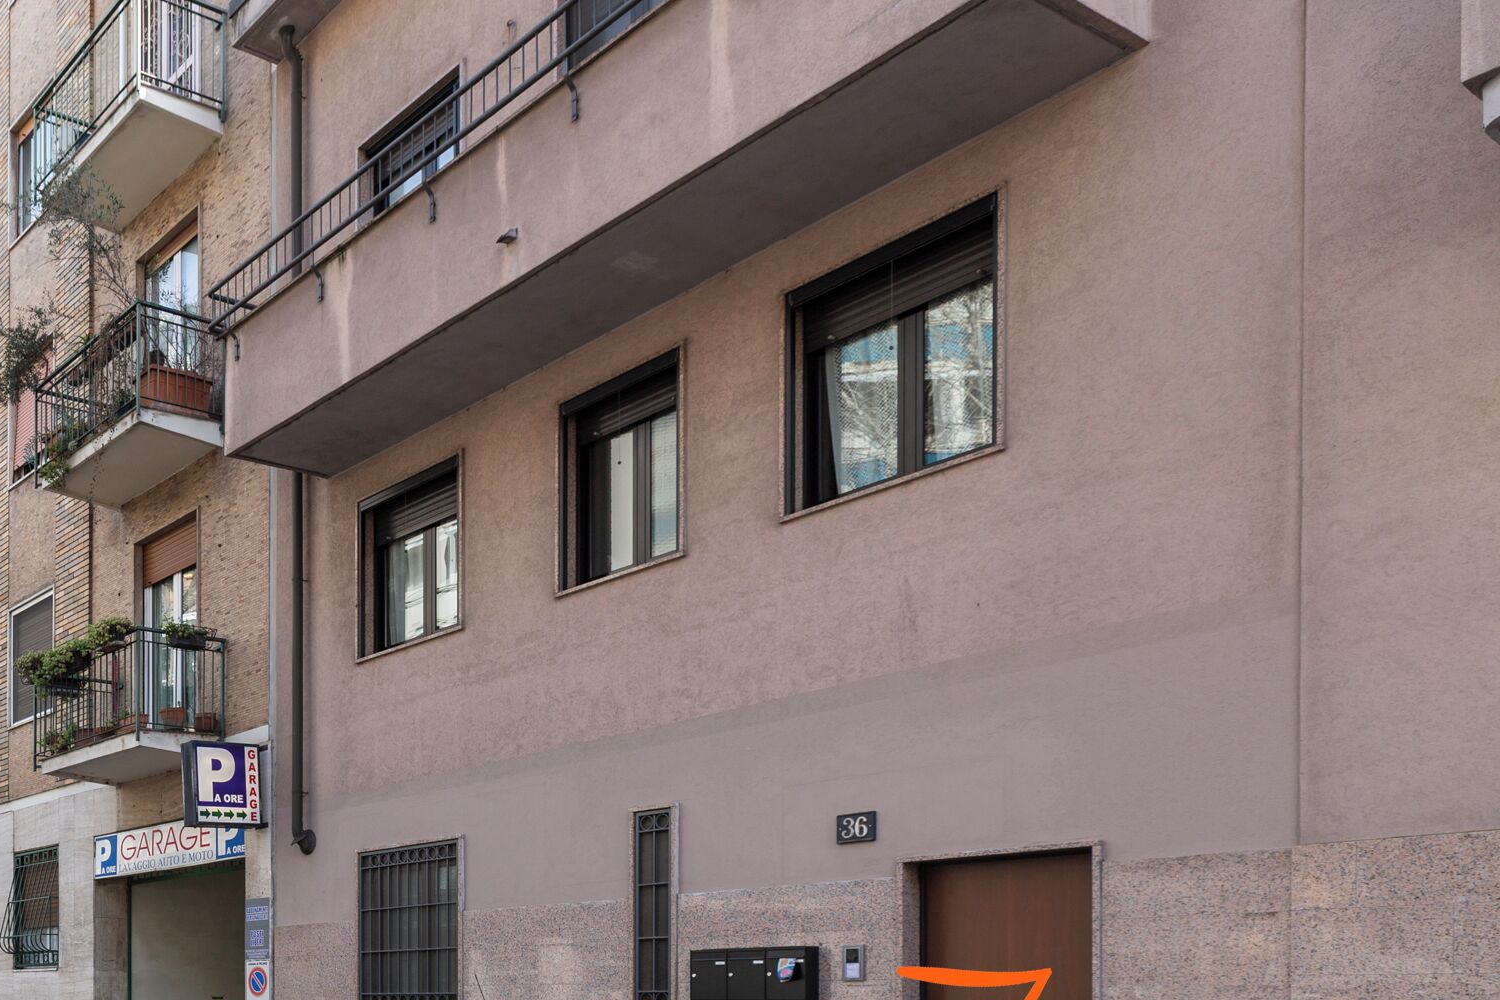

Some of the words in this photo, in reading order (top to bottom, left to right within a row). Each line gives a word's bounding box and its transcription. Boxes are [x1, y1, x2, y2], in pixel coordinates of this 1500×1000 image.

[197, 747, 236, 802] P
[248, 750, 258, 822] GARAGE
[214, 794, 222, 803] A
[223, 794, 244, 804] ORE
[120, 826, 211, 861] GARAGE
[841, 816, 868, 839] 36
[95, 839, 112, 876] P
[118, 859, 156, 873] LAVAGGIO
[157, 854, 180, 868] AUTO
[181, 853, 187, 864] E
[189, 849, 214, 863] MOTO
